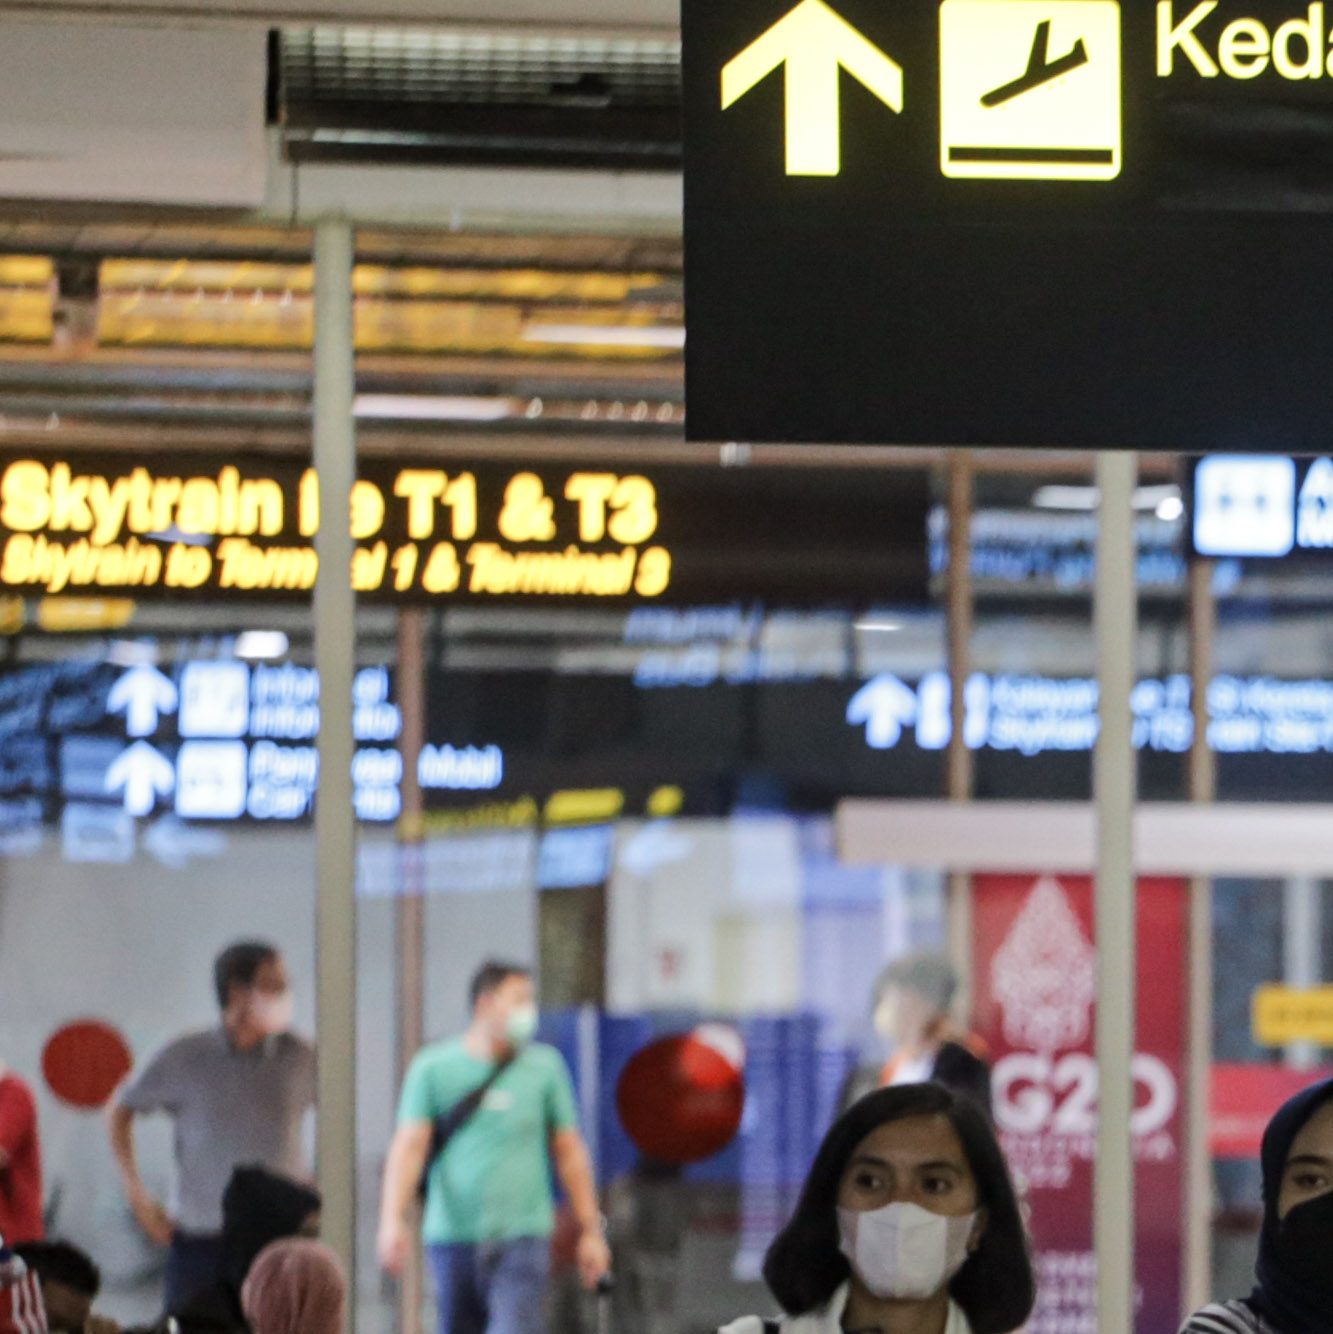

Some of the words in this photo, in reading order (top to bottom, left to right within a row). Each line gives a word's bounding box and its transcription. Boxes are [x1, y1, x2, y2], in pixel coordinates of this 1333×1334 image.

[0, 459, 284, 546] Skytrain
[393, 468, 478, 541] T1
[498, 471, 557, 543] &
[563, 472, 658, 544] T3
